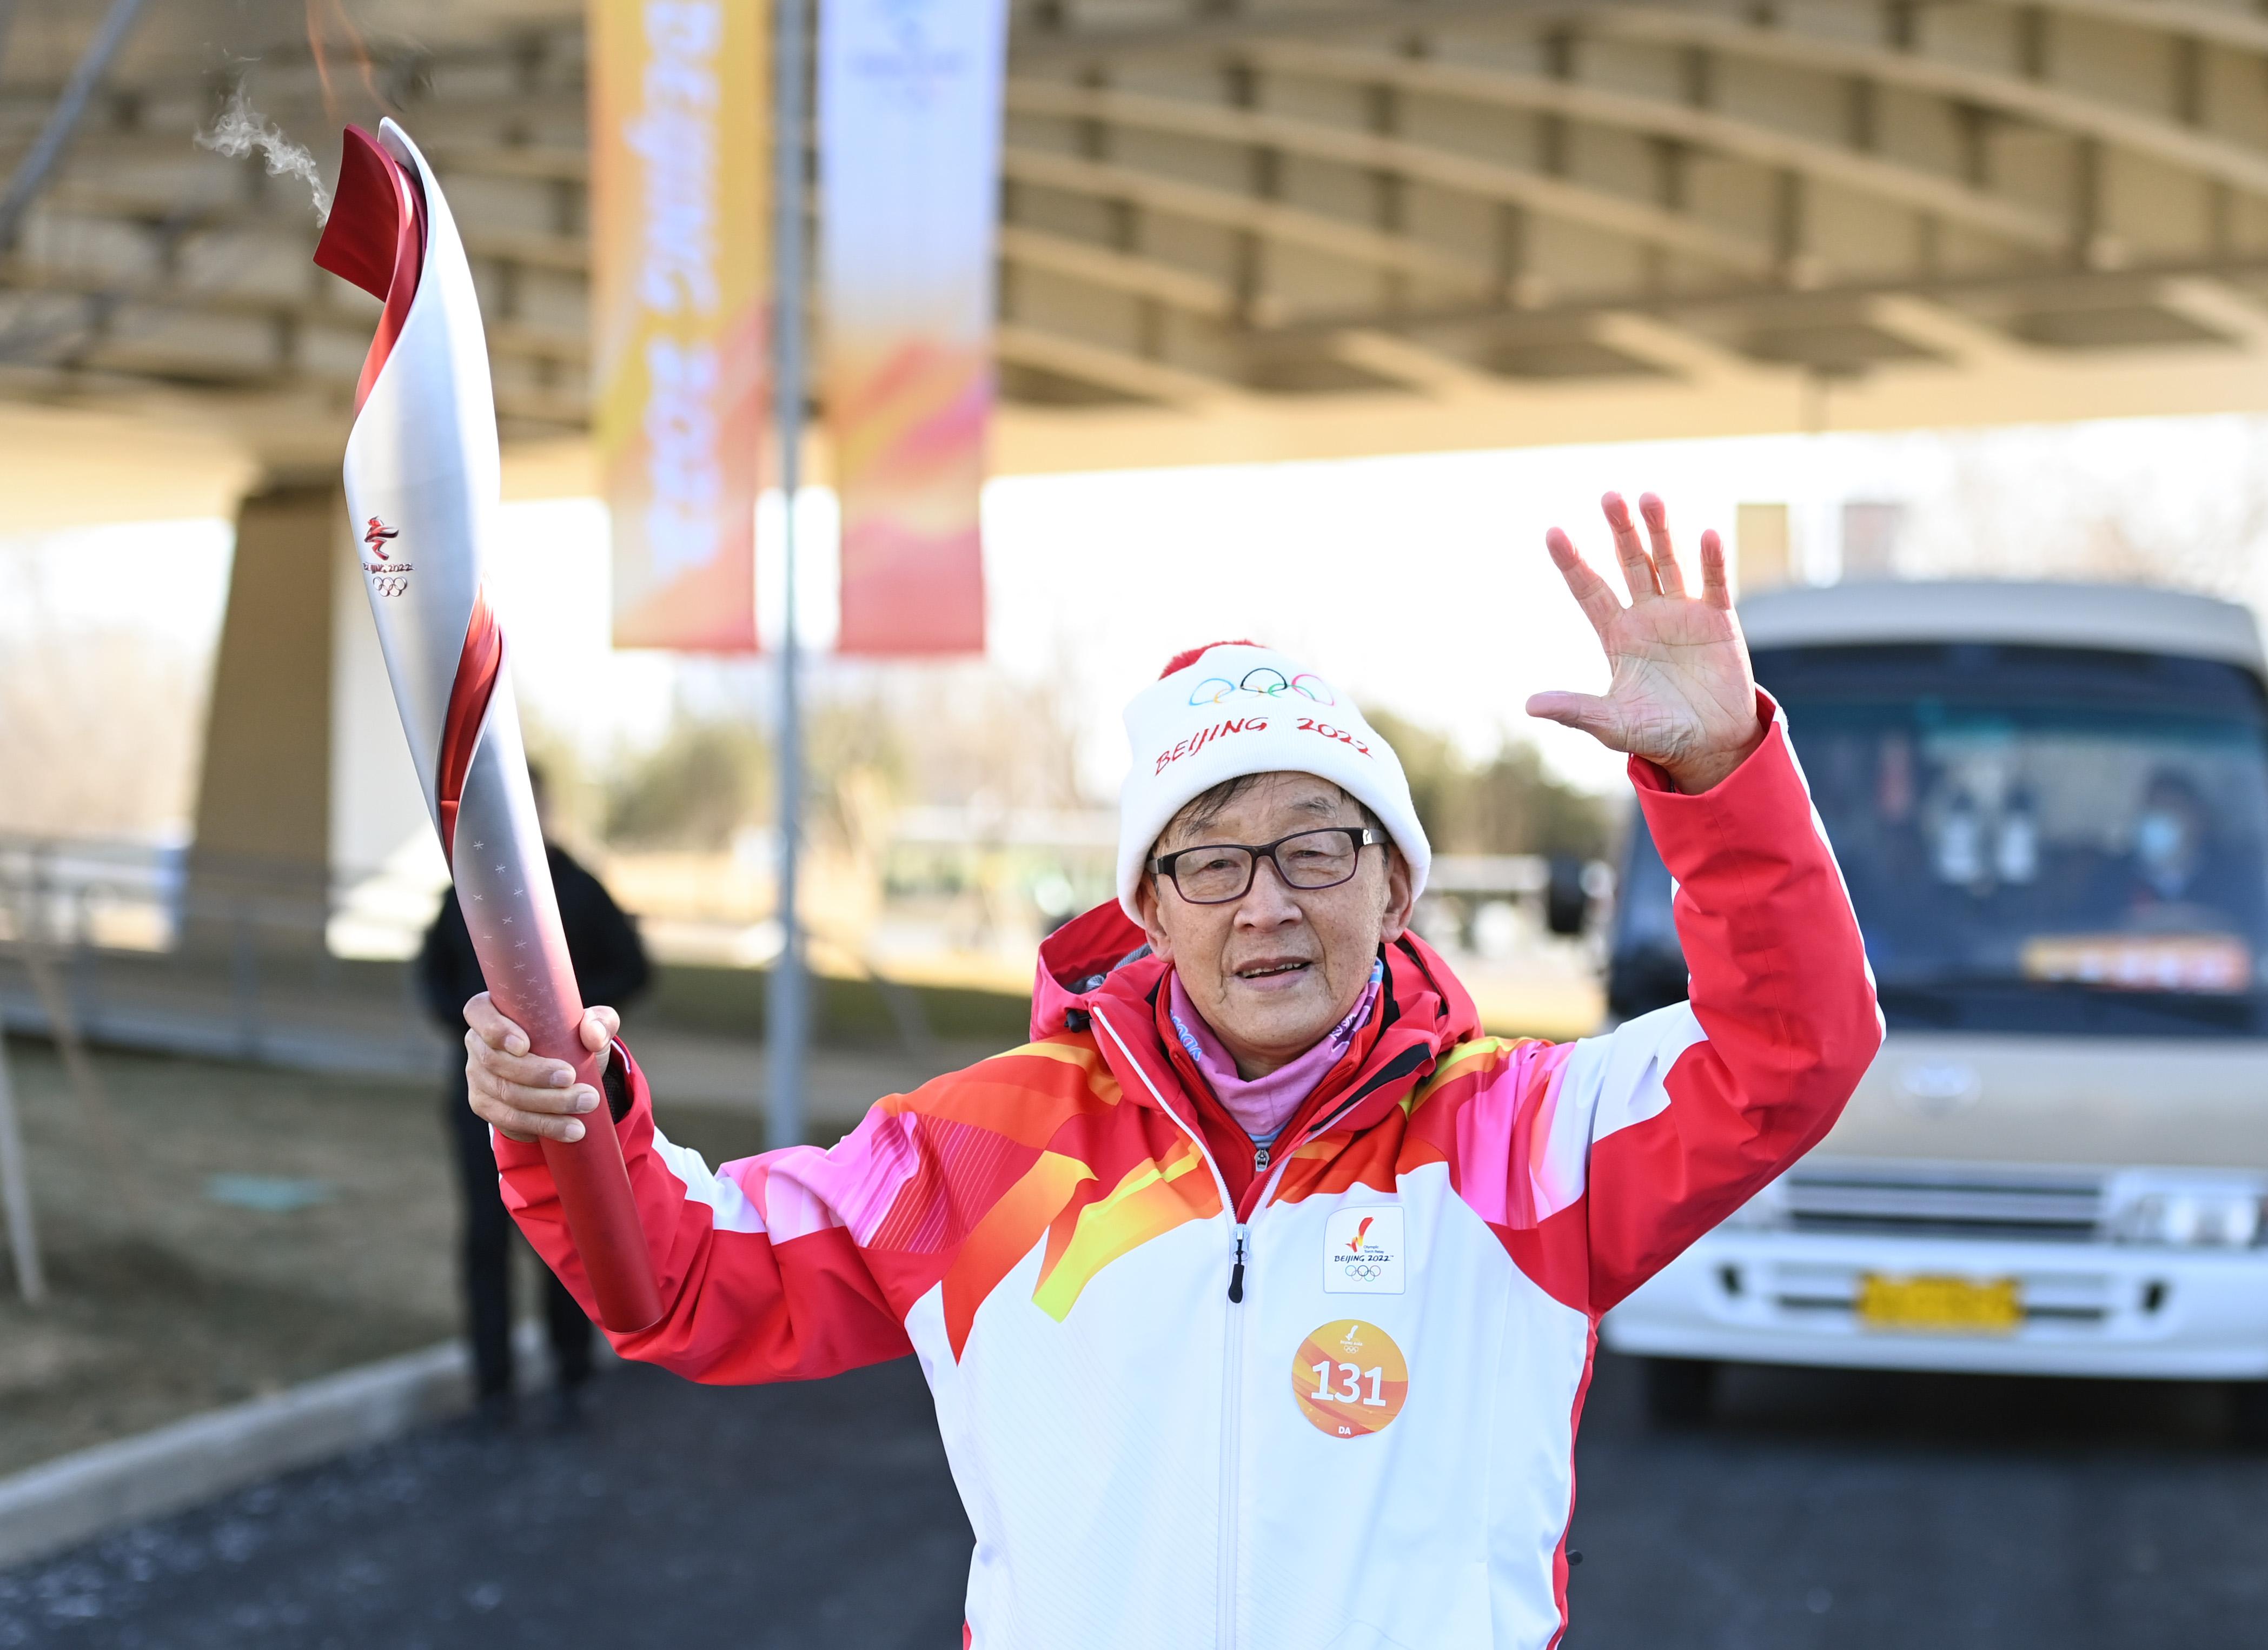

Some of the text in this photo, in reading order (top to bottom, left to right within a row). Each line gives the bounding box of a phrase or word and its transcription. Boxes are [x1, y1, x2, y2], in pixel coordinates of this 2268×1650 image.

[1155, 717, 1374, 776] BEIJING 2022
[1335, 1255, 1365, 1263] BEIJING
[1311, 1360, 1387, 1407] 131
[1338, 1426, 1351, 1435] DA
